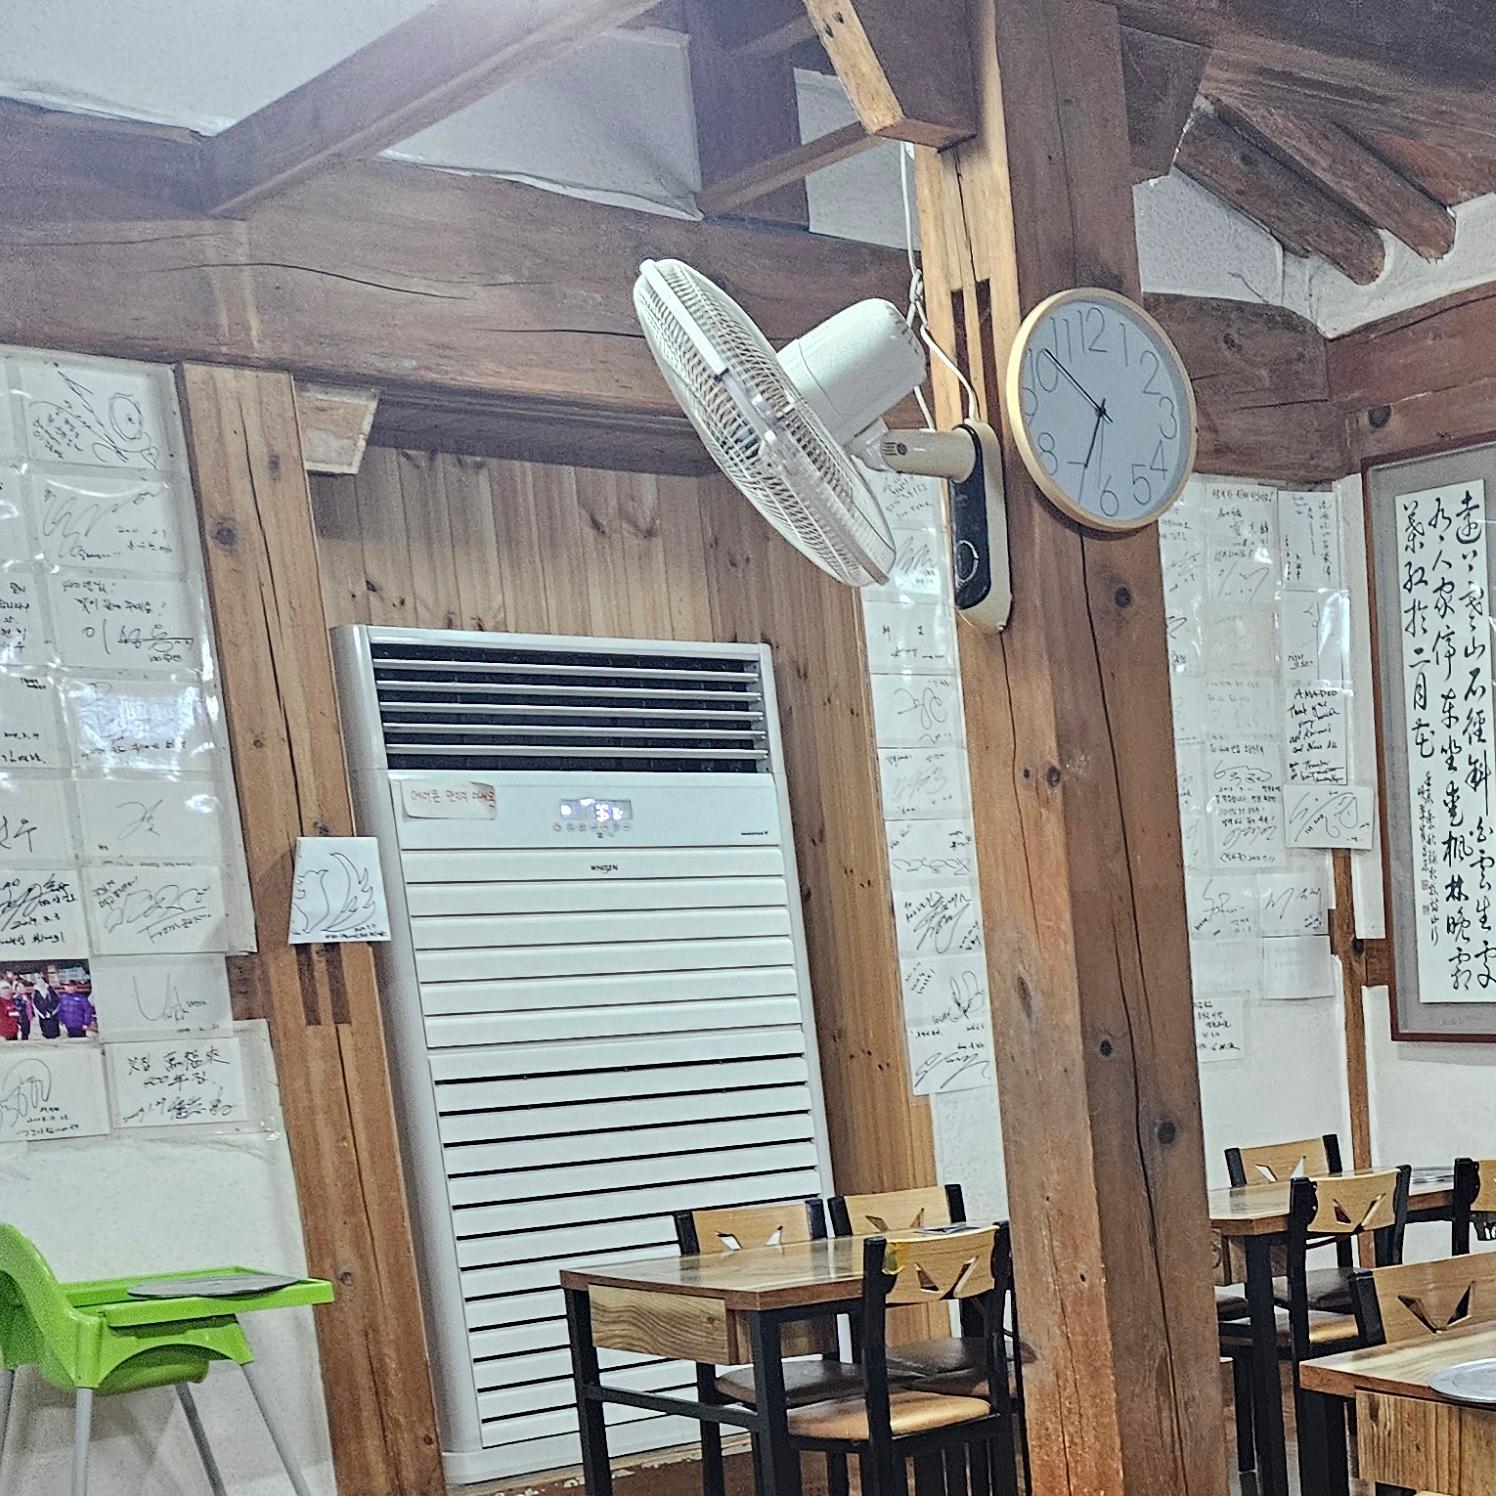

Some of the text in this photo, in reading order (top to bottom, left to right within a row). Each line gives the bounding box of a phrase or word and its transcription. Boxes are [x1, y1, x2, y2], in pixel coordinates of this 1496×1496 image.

[1050, 316, 1073, 363] 11
[1077, 307, 1108, 354] 12
[1119, 322, 1129, 367] 1
[1027, 348, 1059, 394] 10
[1140, 350, 1161, 396] 2
[1158, 396, 1177, 440] 3
[1037, 432, 1059, 475] 8
[1149, 439, 1168, 480] 4
[1067, 460, 1088, 503] 7
[1099, 475, 1120, 517] 6
[1131, 463, 1152, 505] 5
